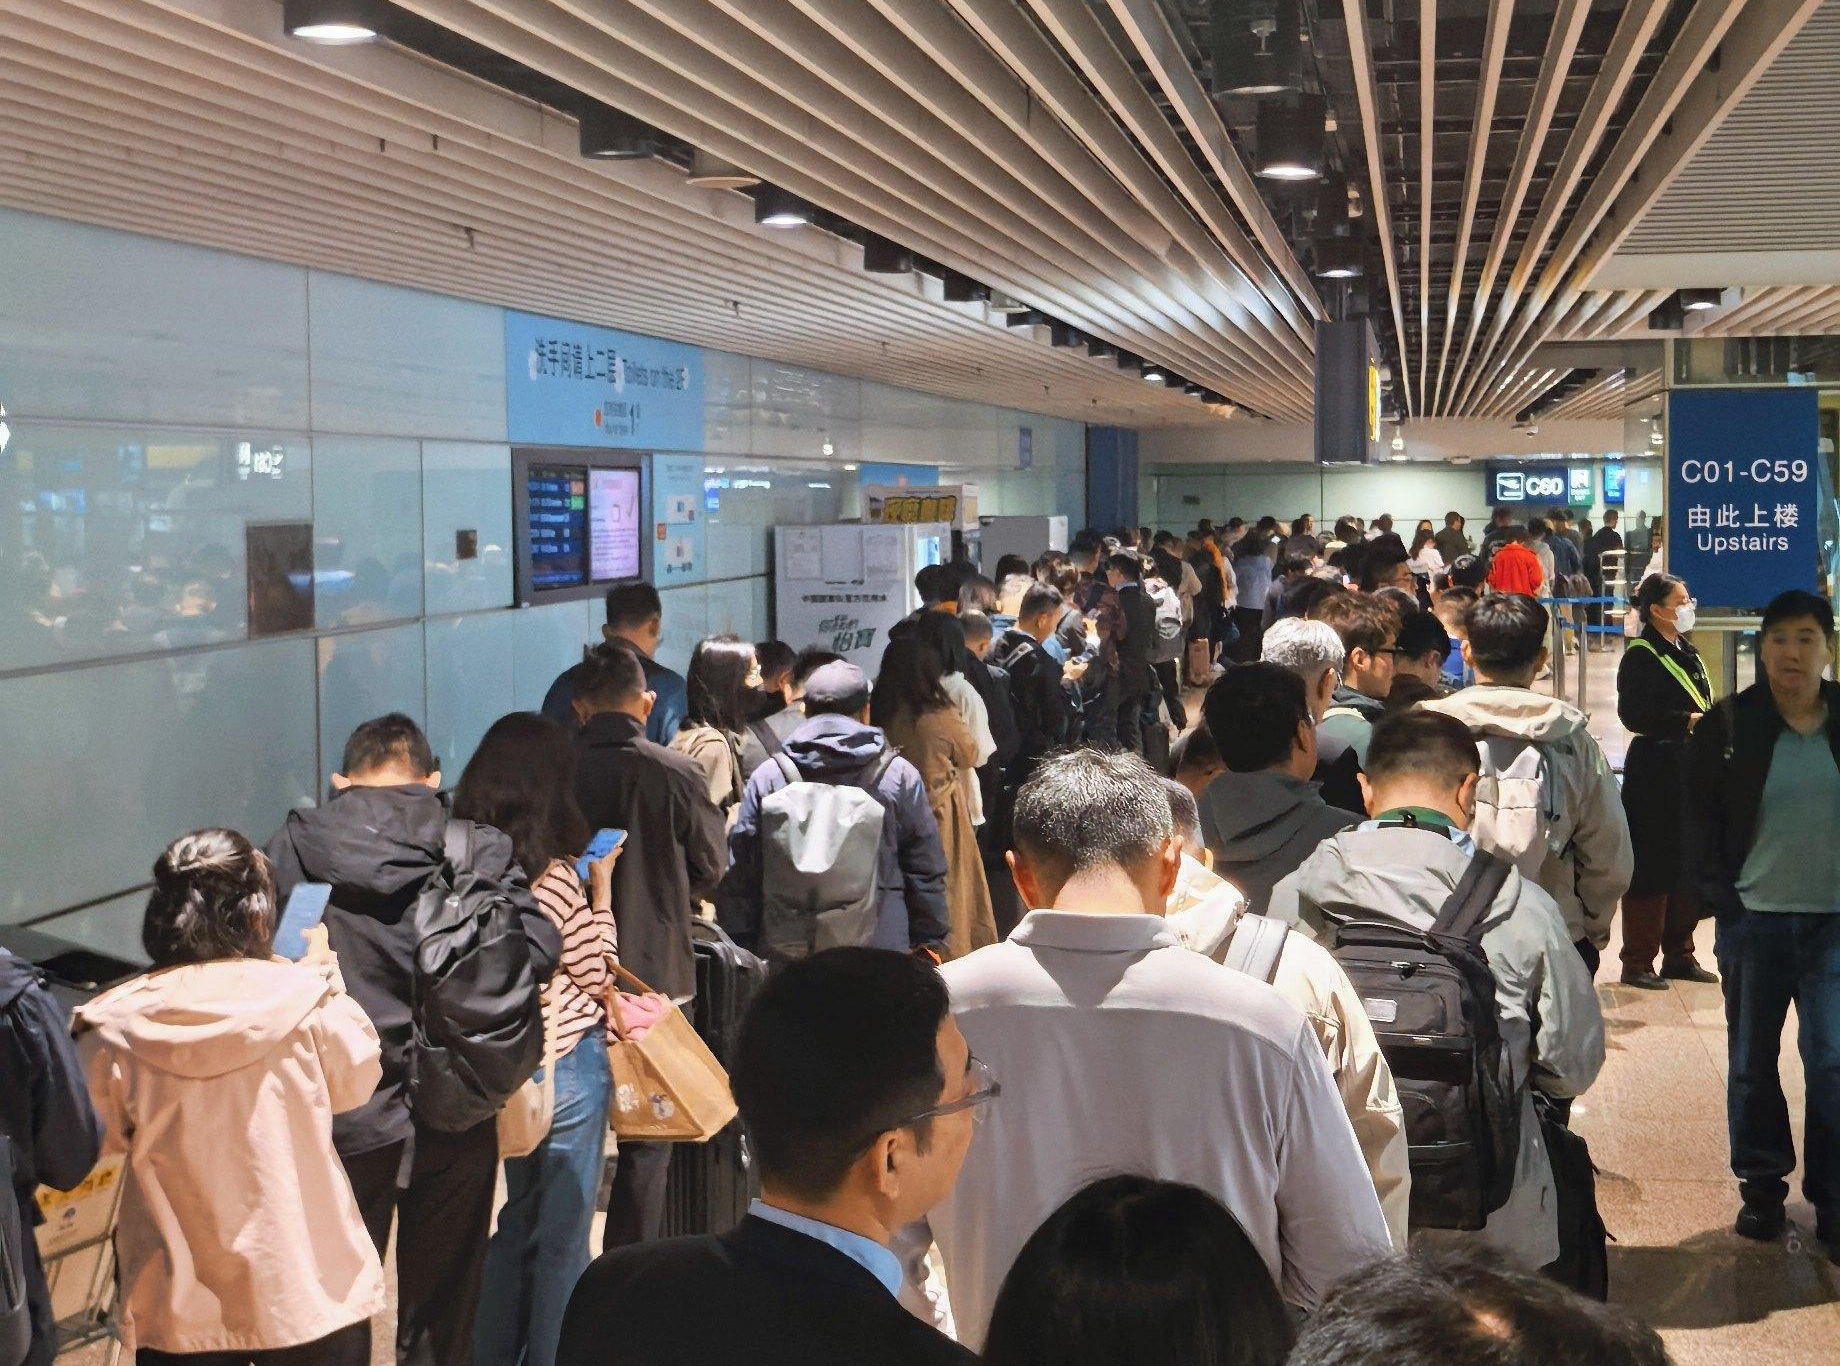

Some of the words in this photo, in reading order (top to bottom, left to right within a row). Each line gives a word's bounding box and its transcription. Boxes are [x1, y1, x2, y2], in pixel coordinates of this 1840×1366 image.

[1681, 459, 1808, 484] C01-C59
[1688, 503, 1799, 528] 由此上楼
[1697, 533, 1789, 555] Upstairs
